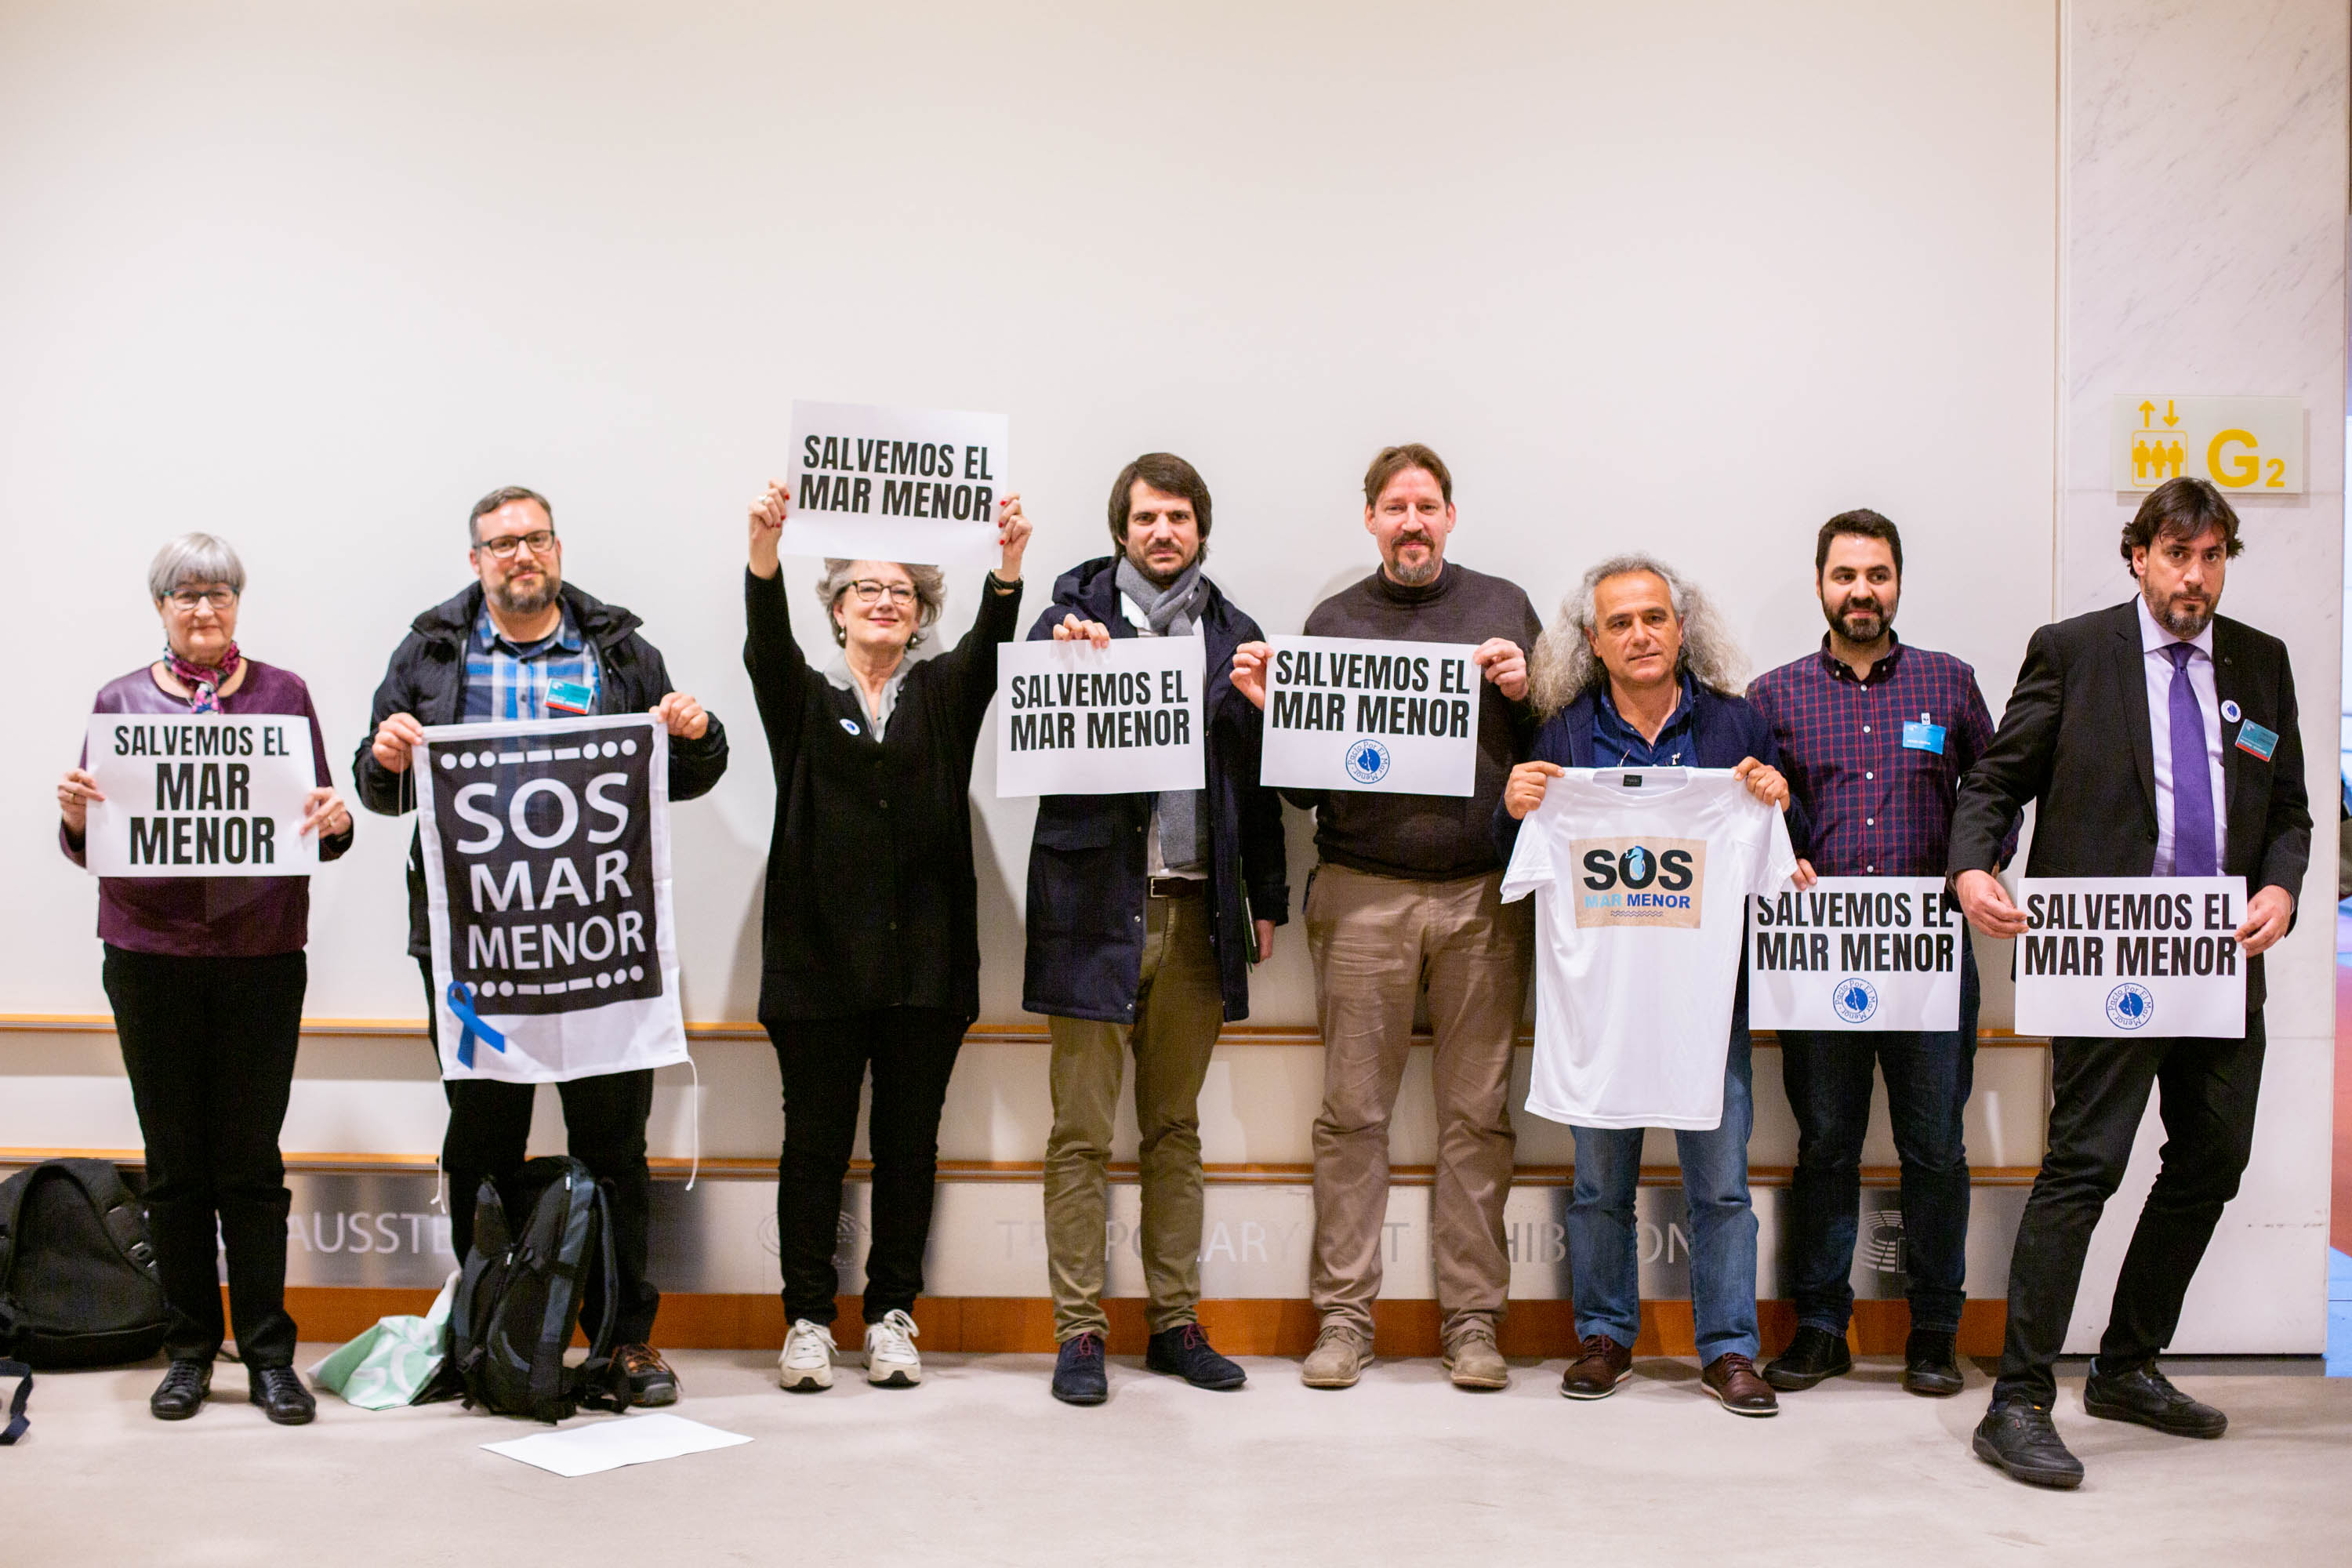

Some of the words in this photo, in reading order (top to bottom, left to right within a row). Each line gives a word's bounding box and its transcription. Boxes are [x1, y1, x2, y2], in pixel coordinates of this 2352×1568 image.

[804, 435, 954, 478] SALVEMOS
[964, 446, 993, 481] EL
[799, 474, 872, 514] MAR
[882, 479, 993, 522] MENOR
[1011, 670, 1151, 710] SALVEMOS
[1161, 670, 1189, 704] EL
[1276, 650, 1429, 692] SALVEMOS
[1439, 659, 1470, 695] EL
[1011, 712, 1075, 752] MAR
[1087, 709, 1190, 749] MENOR
[1272, 690, 1345, 731] MAR
[1356, 695, 1470, 739] MENOR
[114, 725, 253, 757] SALVEMOS
[264, 726, 289, 756] EL
[157, 763, 250, 811] MAR
[454, 772, 629, 855] SOS
[130, 816, 275, 865] MENOR
[470, 850, 632, 913] MAR
[1583, 848, 1693, 891] SOS
[1584, 893, 1622, 909] MAR
[1627, 893, 1690, 909] MENOR
[1757, 891, 1911, 927] SALVEMOS
[1922, 892, 1954, 928] EL
[2026, 894, 2192, 931] SALVEMOS
[2204, 893, 2237, 931] EL
[469, 910, 645, 970] MENOR
[1756, 931, 1829, 971] MAR
[1841, 933, 1955, 972] MENOR
[2025, 935, 2103, 976] MAR
[2116, 935, 2238, 977] MENOR
[287, 1212, 453, 1254] AUSSTE
